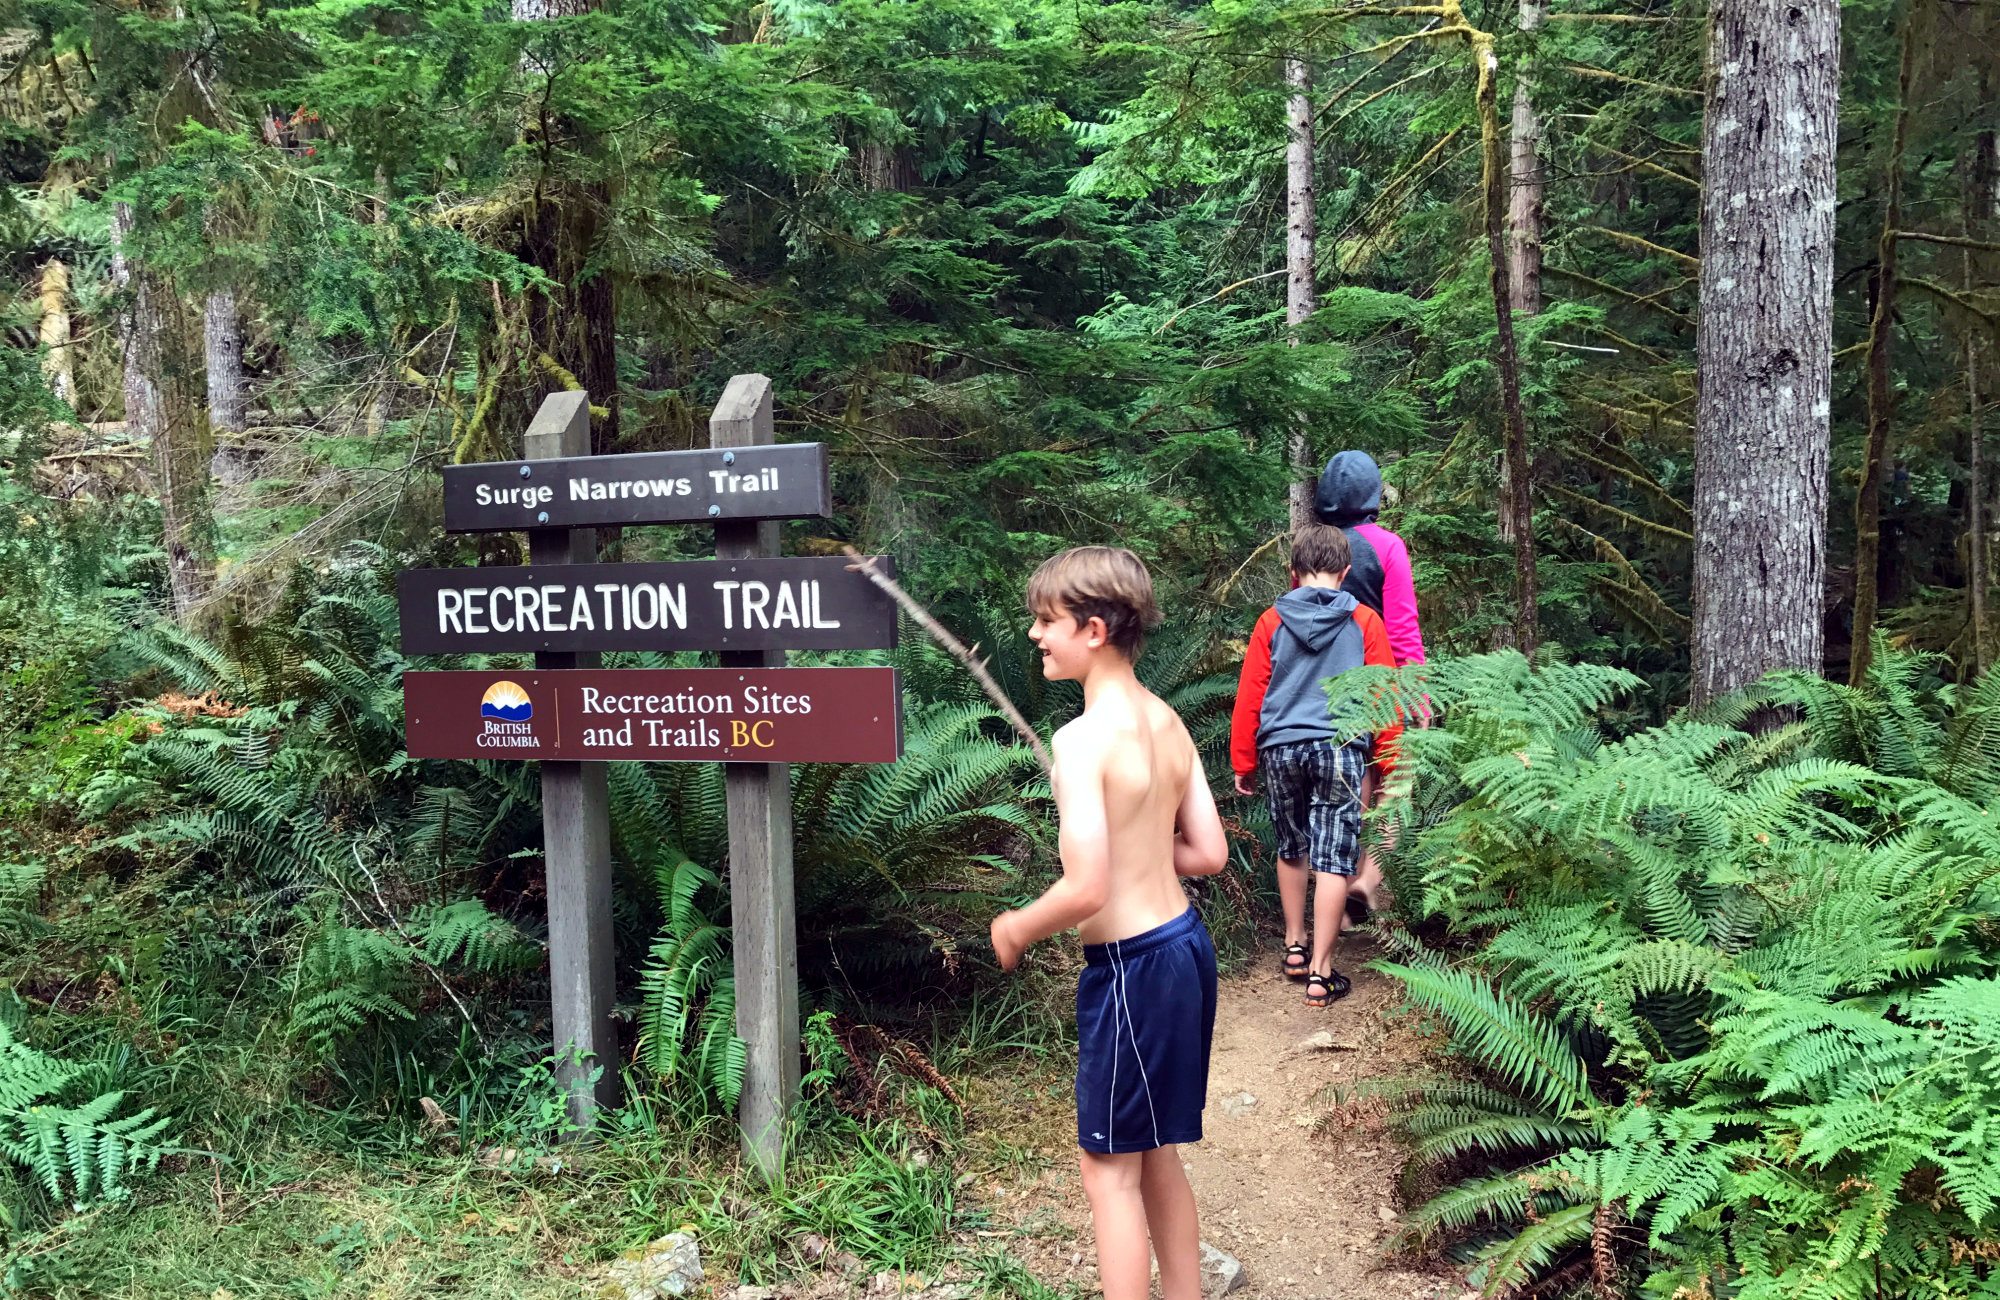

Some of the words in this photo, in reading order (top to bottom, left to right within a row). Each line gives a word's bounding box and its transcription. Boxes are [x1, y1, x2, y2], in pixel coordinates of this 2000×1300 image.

[475, 483, 553, 508] Surge
[569, 476, 692, 501] Narrows
[709, 468, 779, 494] Trail
[437, 582, 688, 634] RECREATION
[713, 579, 841, 630] TRAIL
[581, 687, 734, 715] Recreation
[744, 686, 812, 714] Sites
[476, 734, 540, 748] COLUMBIA
[484, 721, 532, 735] BRITISH
[583, 720, 634, 747] and
[642, 719, 721, 747] Trails
[731, 720, 775, 748] BC
